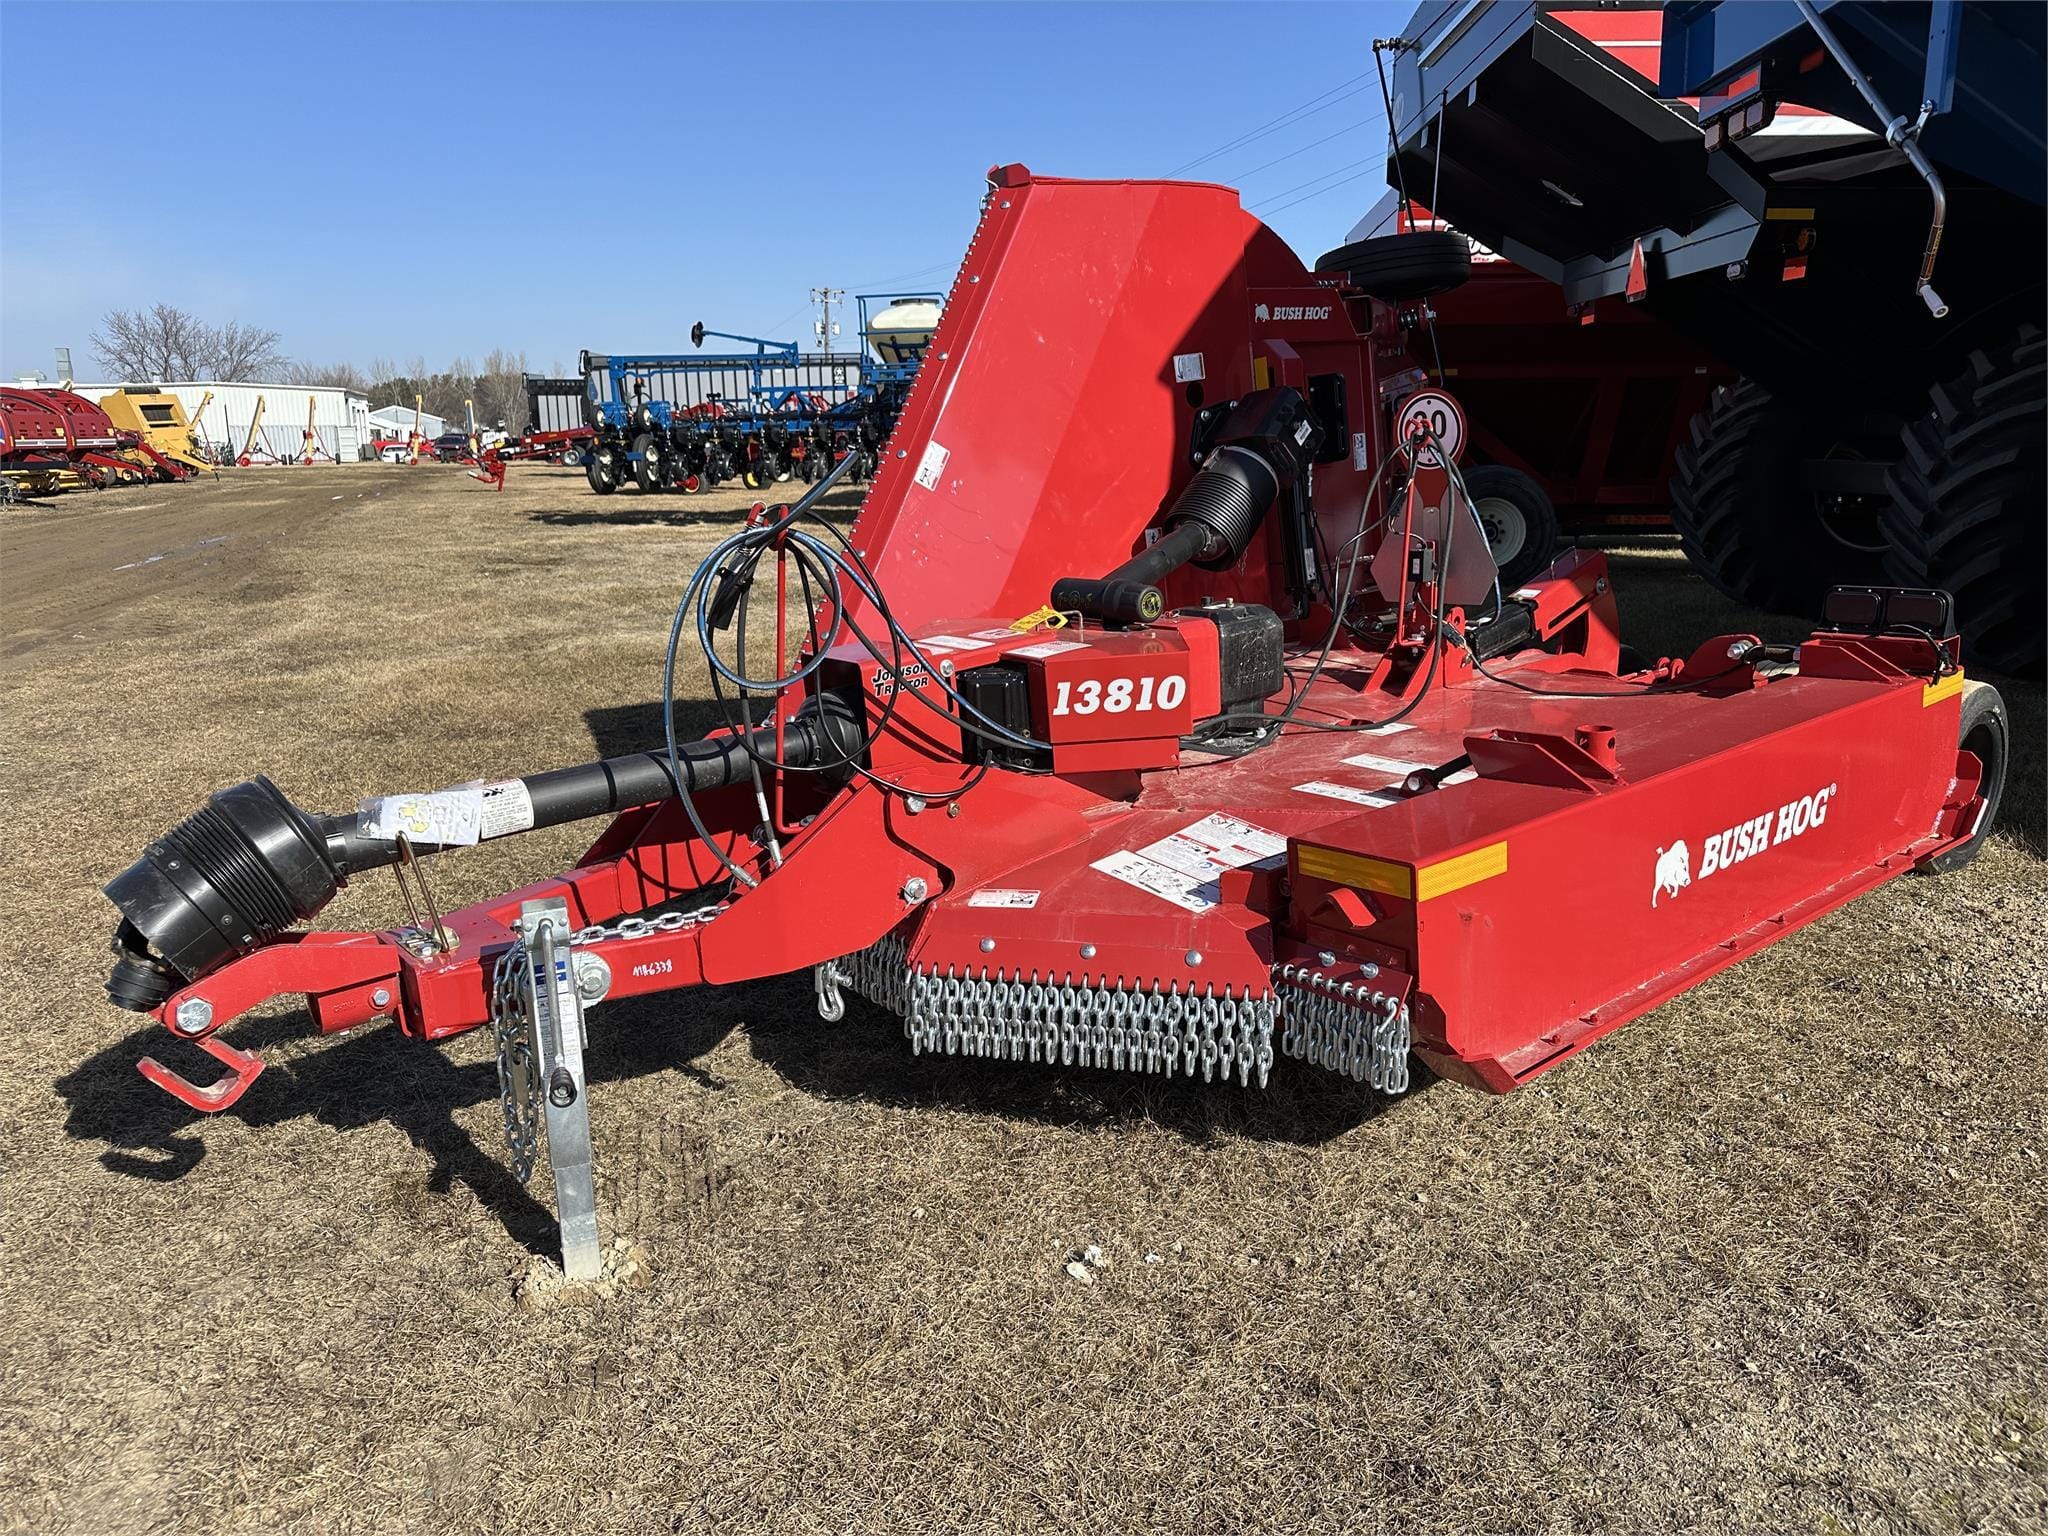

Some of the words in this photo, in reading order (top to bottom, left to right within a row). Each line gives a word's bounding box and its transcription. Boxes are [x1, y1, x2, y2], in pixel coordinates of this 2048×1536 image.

[1272, 306, 1303, 321] BUSH
[872, 664, 928, 684] JOSON
[874, 677, 929, 697] TRCOR
[1052, 675, 1187, 716] 13810
[1697, 810, 1775, 881] BUSH
